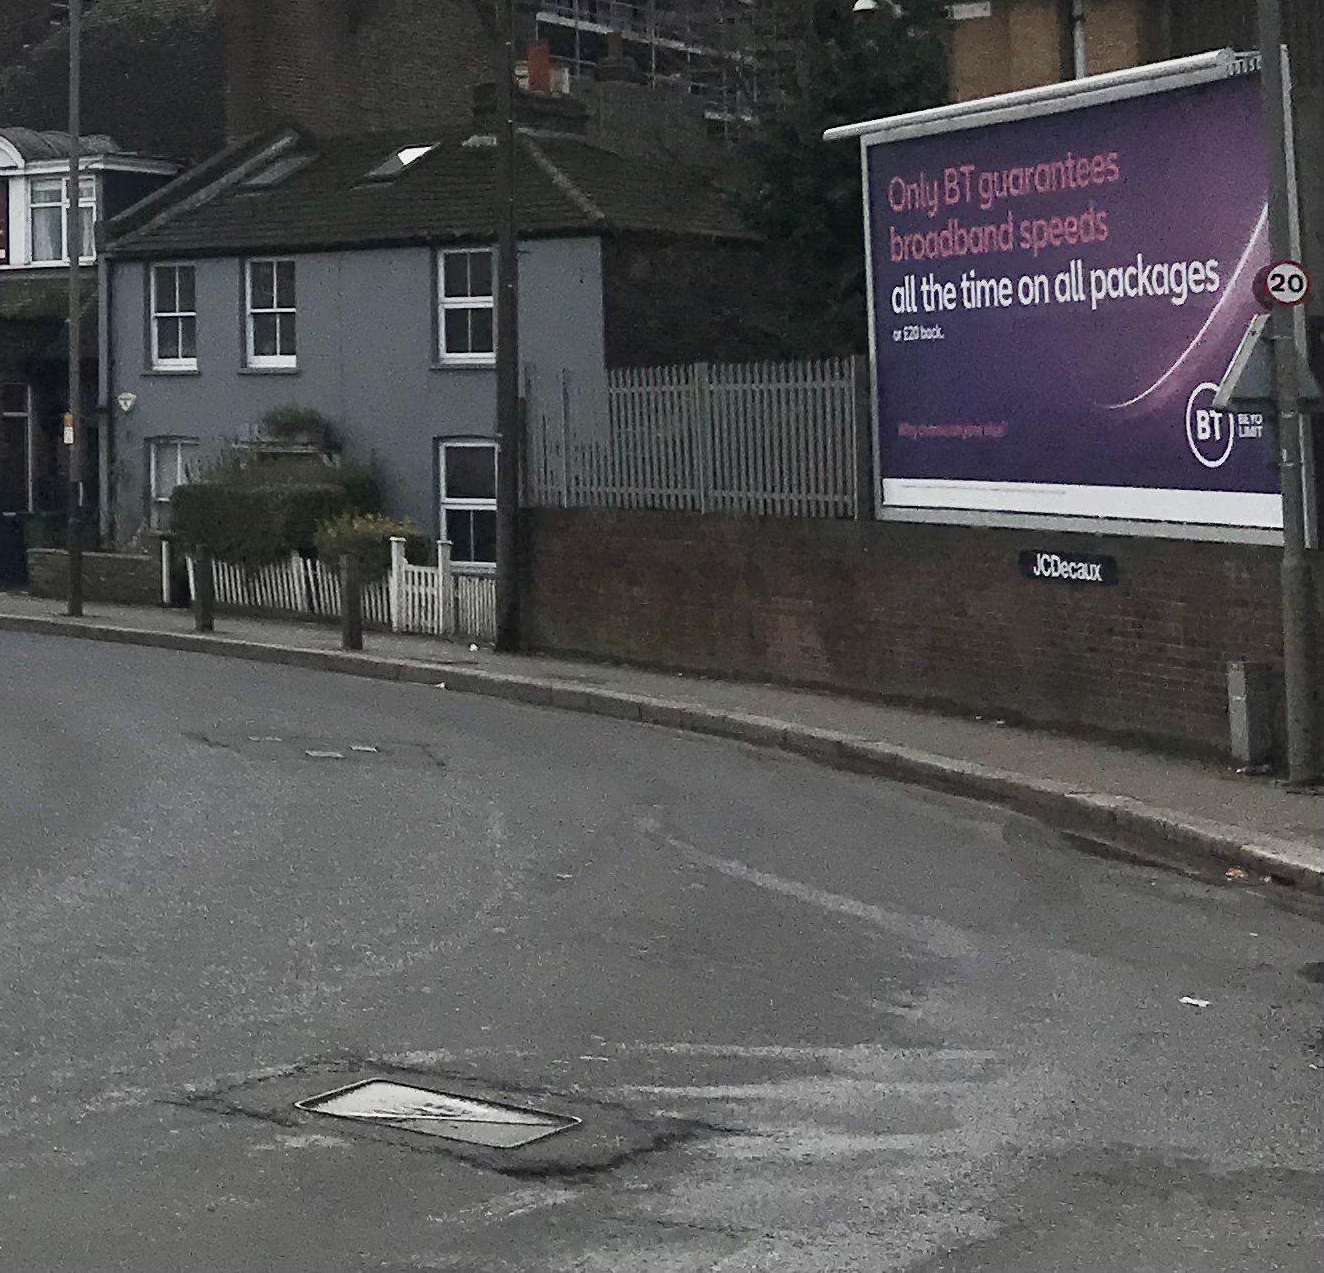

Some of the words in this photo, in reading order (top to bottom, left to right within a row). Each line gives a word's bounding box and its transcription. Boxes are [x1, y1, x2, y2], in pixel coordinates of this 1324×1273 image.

[888, 172, 938, 218] Only
[944, 166, 975, 206] BT
[978, 152, 1120, 210] guarantees
[890, 210, 1014, 263] broadband
[1020, 201, 1108, 257] speeds
[891, 274, 917, 314] all
[921, 273, 956, 311] the
[960, 269, 1013, 309] time
[1017, 273, 1050, 306] on
[1054, 259, 1086, 303] all
[1089, 253, 1221, 311] packages
[1270, 273, 1304, 293] 20
[1196, 409, 1223, 441] BT
[1237, 413, 1263, 425] BEYO
[1033, 553, 1103, 582] JCDecaux
